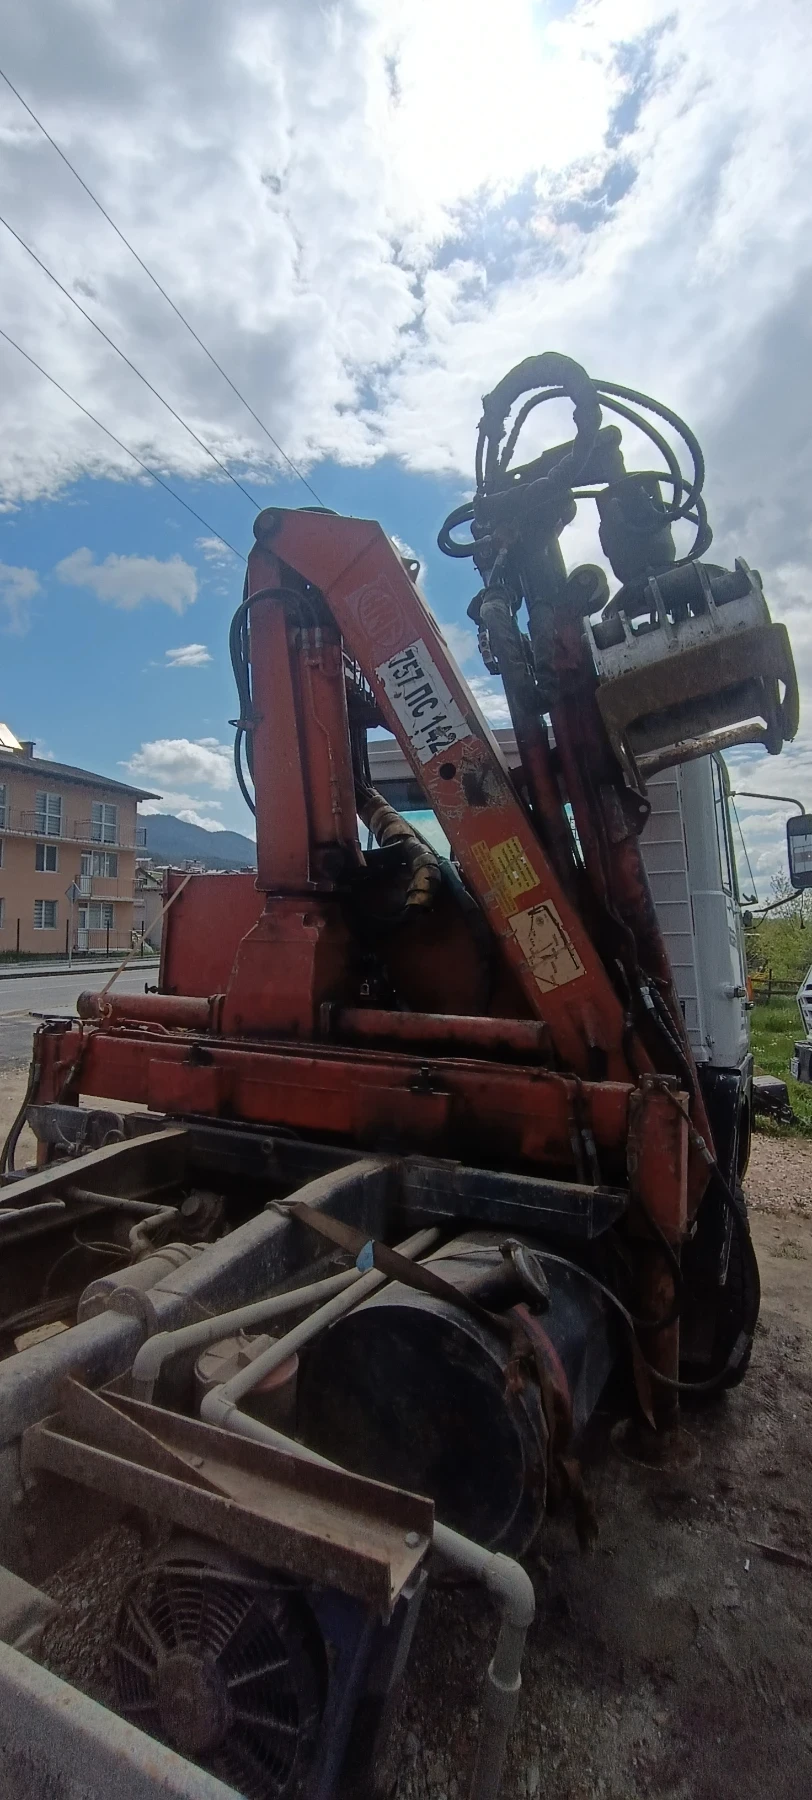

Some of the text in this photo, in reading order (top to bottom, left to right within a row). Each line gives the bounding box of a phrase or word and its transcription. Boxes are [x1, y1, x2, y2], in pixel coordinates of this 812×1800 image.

[388, 649, 456, 754] 757 ПС 142
